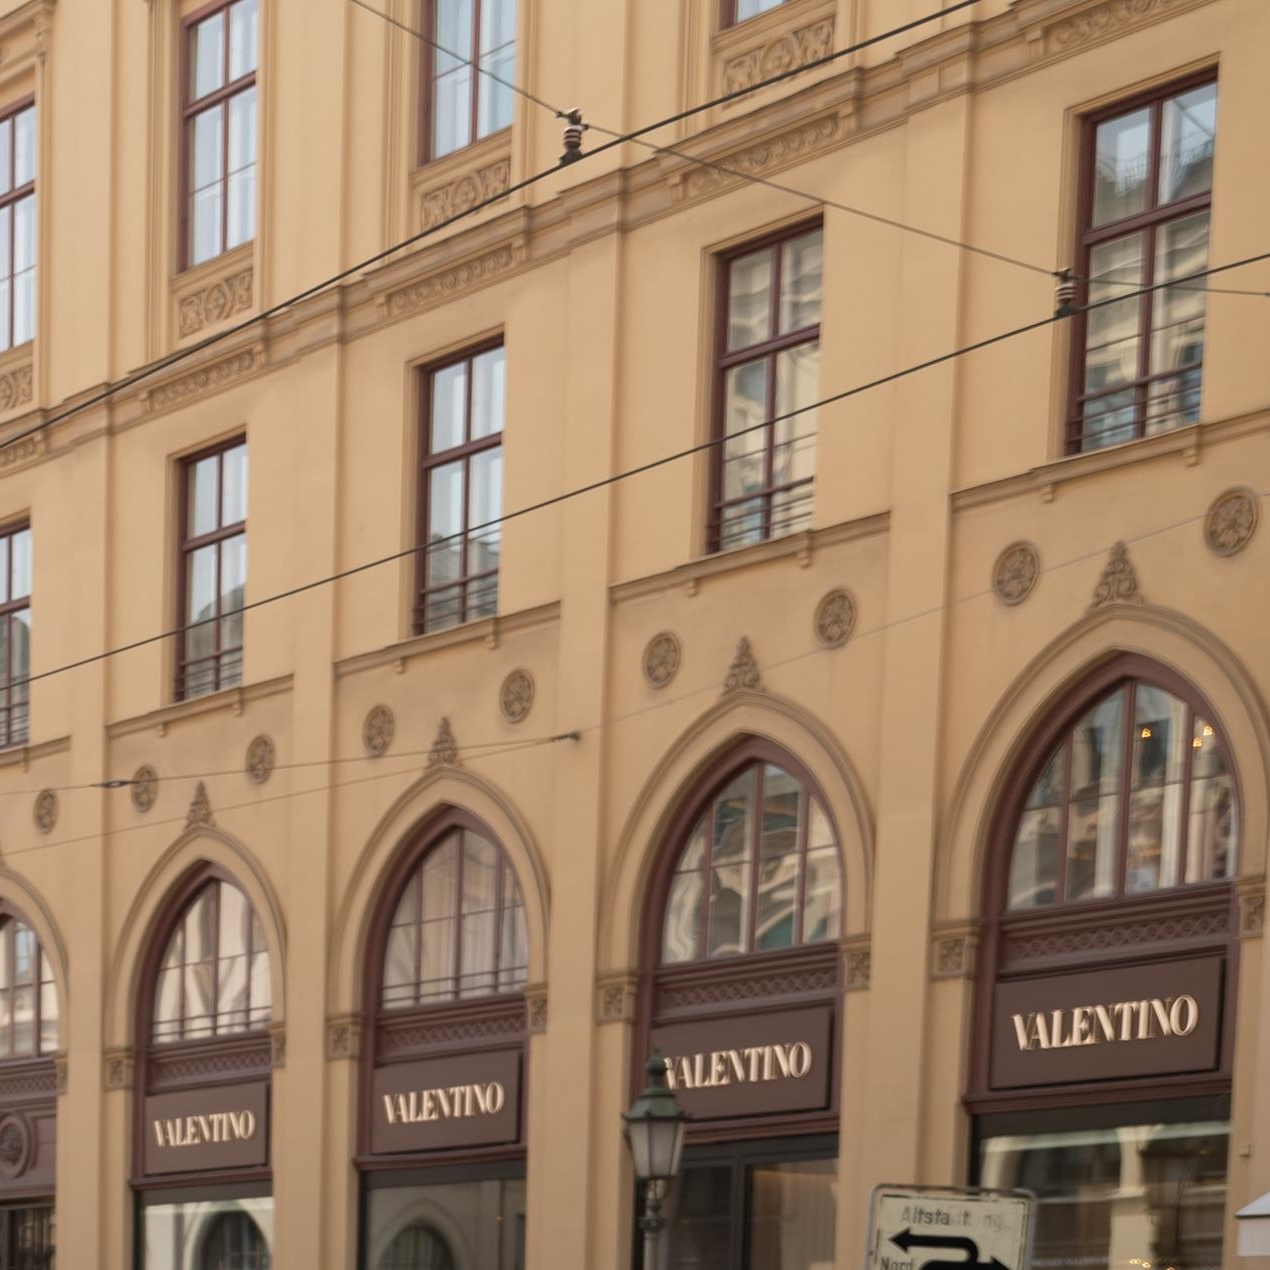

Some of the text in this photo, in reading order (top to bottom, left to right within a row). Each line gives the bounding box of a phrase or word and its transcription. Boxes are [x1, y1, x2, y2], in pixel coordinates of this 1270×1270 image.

[1011, 994, 1199, 1051] VALENTINO
[664, 1041, 812, 1089] VALENTINO
[384, 1082, 505, 1124] VALENTINO
[154, 1110, 255, 1147] VALENTINO
